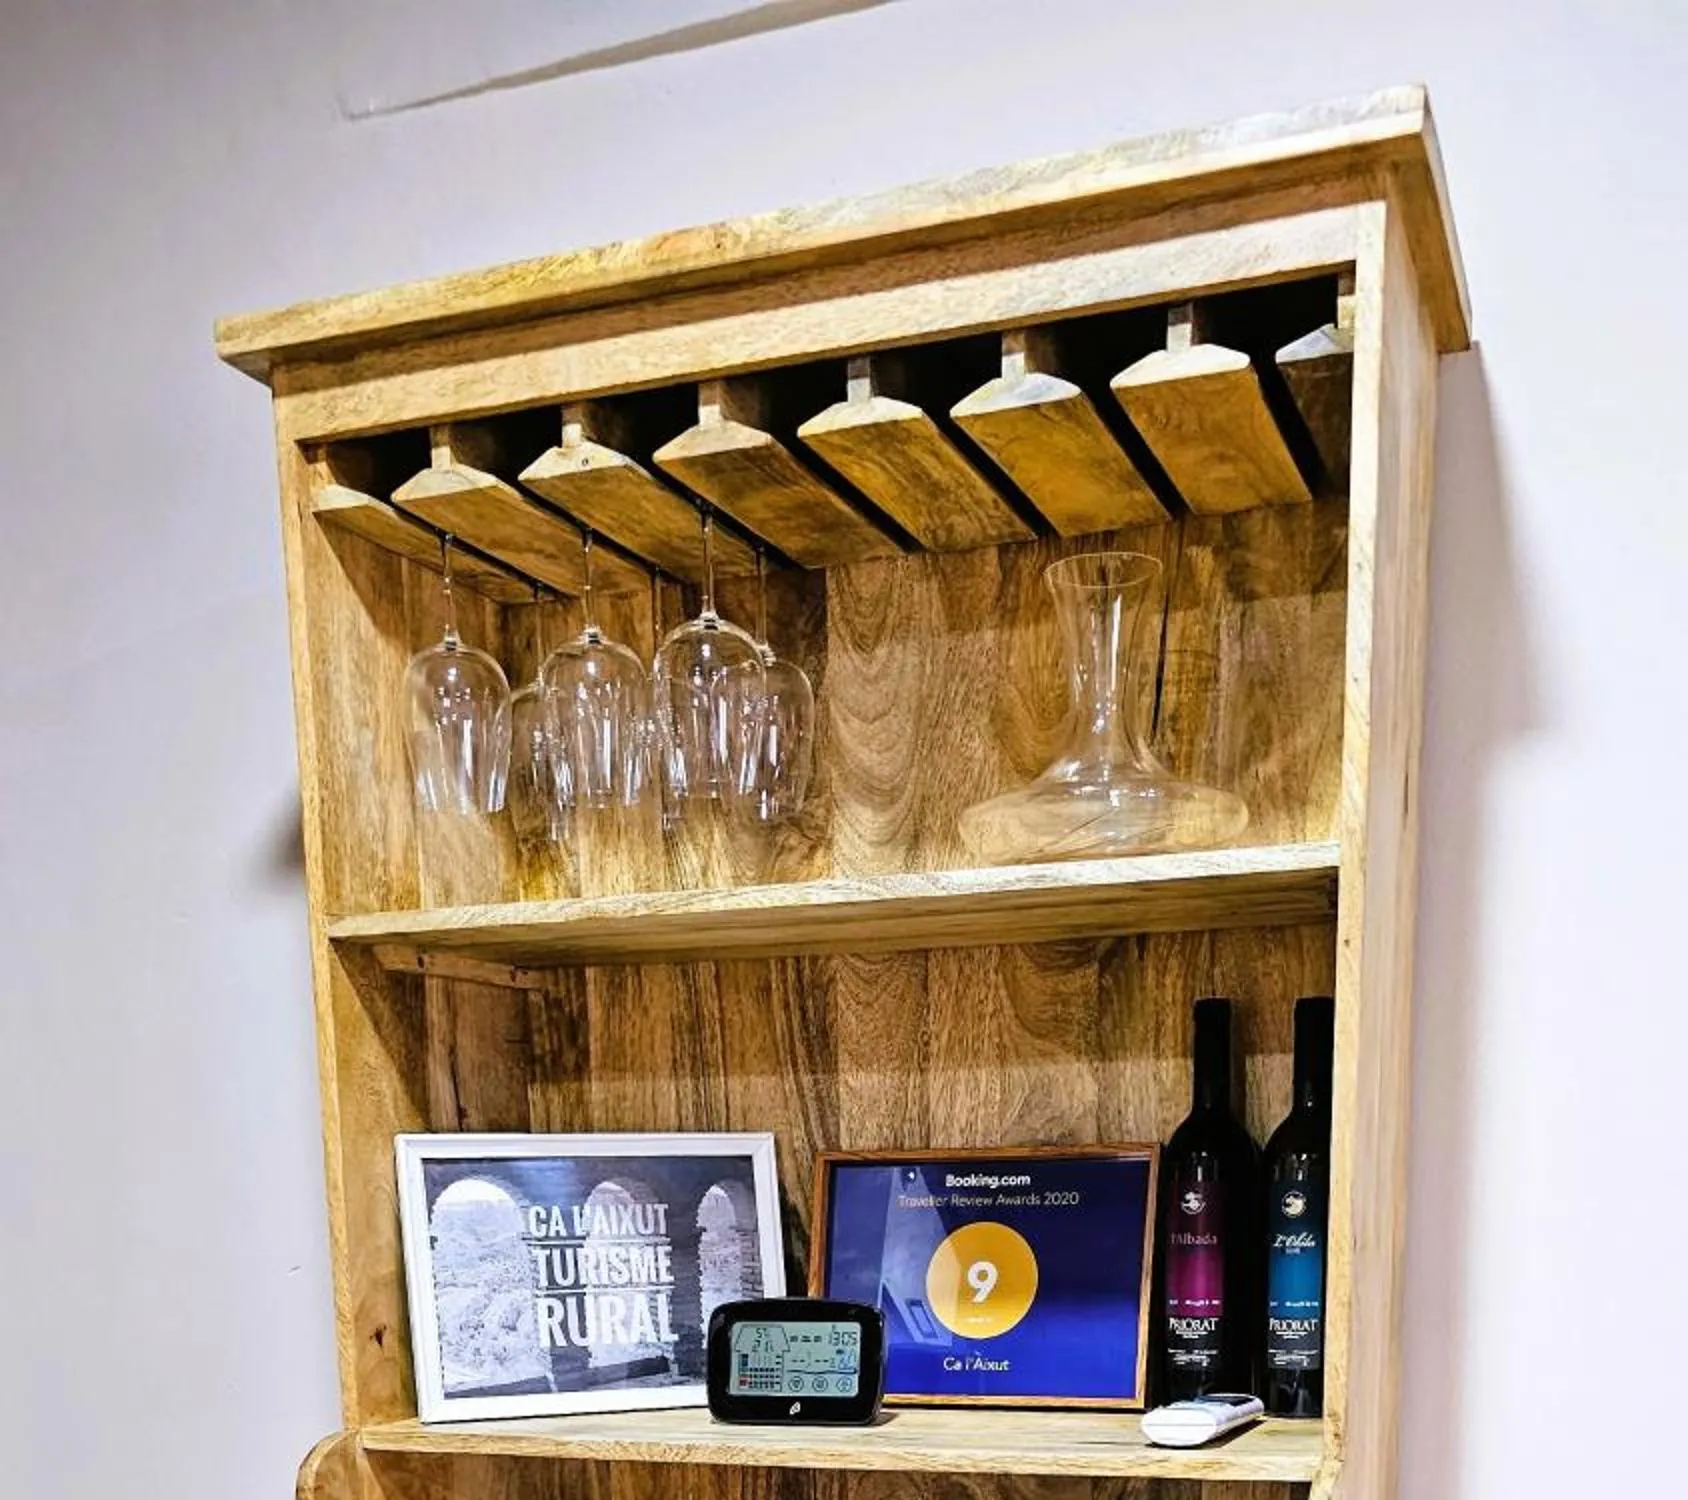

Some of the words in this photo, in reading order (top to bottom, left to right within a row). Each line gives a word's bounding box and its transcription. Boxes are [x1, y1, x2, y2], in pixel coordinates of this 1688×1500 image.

[945, 1173, 1031, 1188] Booking.com
[898, 1194, 949, 1208] Traveller
[952, 1193, 993, 1207] Review
[996, 1193, 1041, 1206] Awards
[1044, 1191, 1080, 1205] 2020
[529, 1205, 567, 1238] CA
[532, 1245, 675, 1288] TURISME
[967, 1261, 998, 1303] 9
[536, 1292, 680, 1349] RURAL
[1169, 1317, 1219, 1331] PRIORAT
[1269, 1318, 1319, 1332] PRIORAT
[943, 1356, 962, 1371] Ca
